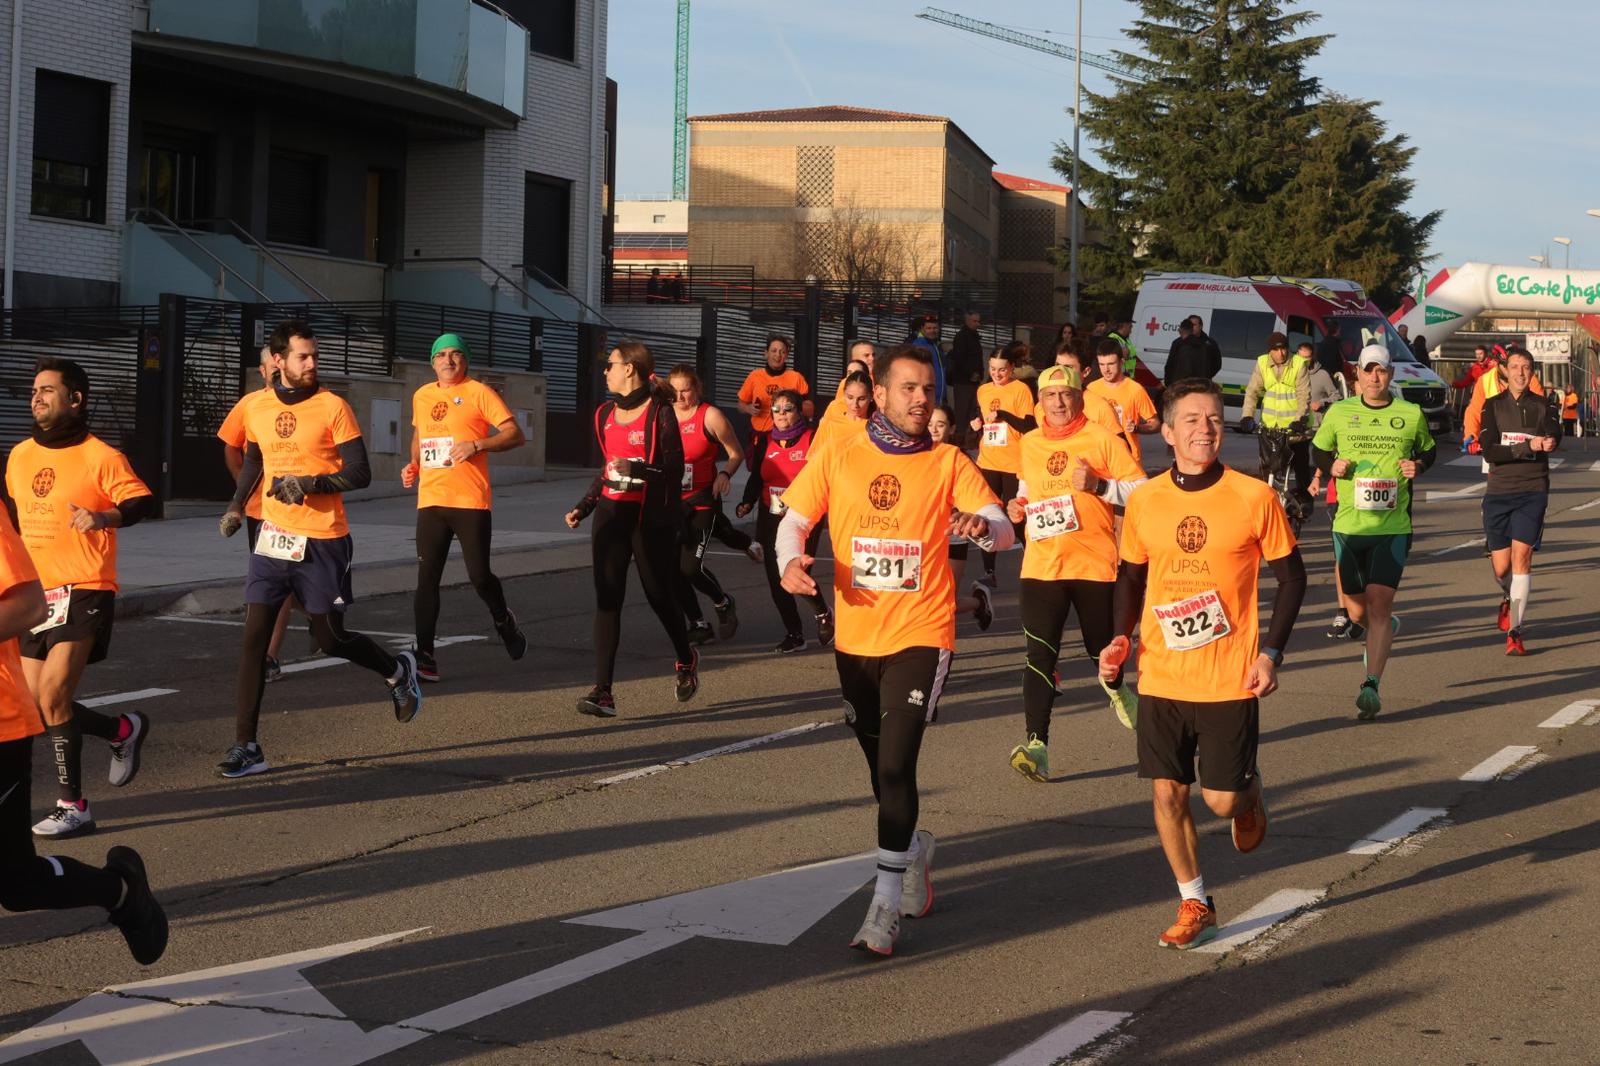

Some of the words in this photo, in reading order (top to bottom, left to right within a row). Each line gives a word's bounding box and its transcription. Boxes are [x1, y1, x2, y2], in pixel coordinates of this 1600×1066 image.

[1199, 283, 1250, 293] AMBULANCIA
[1496, 274, 1514, 294] El
[1517, 277, 1560, 296] Corte
[1346, 434, 1403, 443] CORRECAMINOS
[1353, 442, 1396, 450] CARBAJOSA
[271, 442, 300, 454] UPSA
[1042, 479, 1071, 492] UPSA
[1364, 489, 1389, 502] 300
[25, 502, 56, 515] UPSA
[860, 515, 900, 531] UPSA
[1036, 510, 1065, 529] 383
[270, 534, 296, 551] 185
[853, 540, 920, 556] bedunia
[865, 556, 904, 578] 281
[1171, 559, 1211, 575] UPSA
[1155, 594, 1217, 619] bedunia
[1171, 611, 1212, 638] 322
